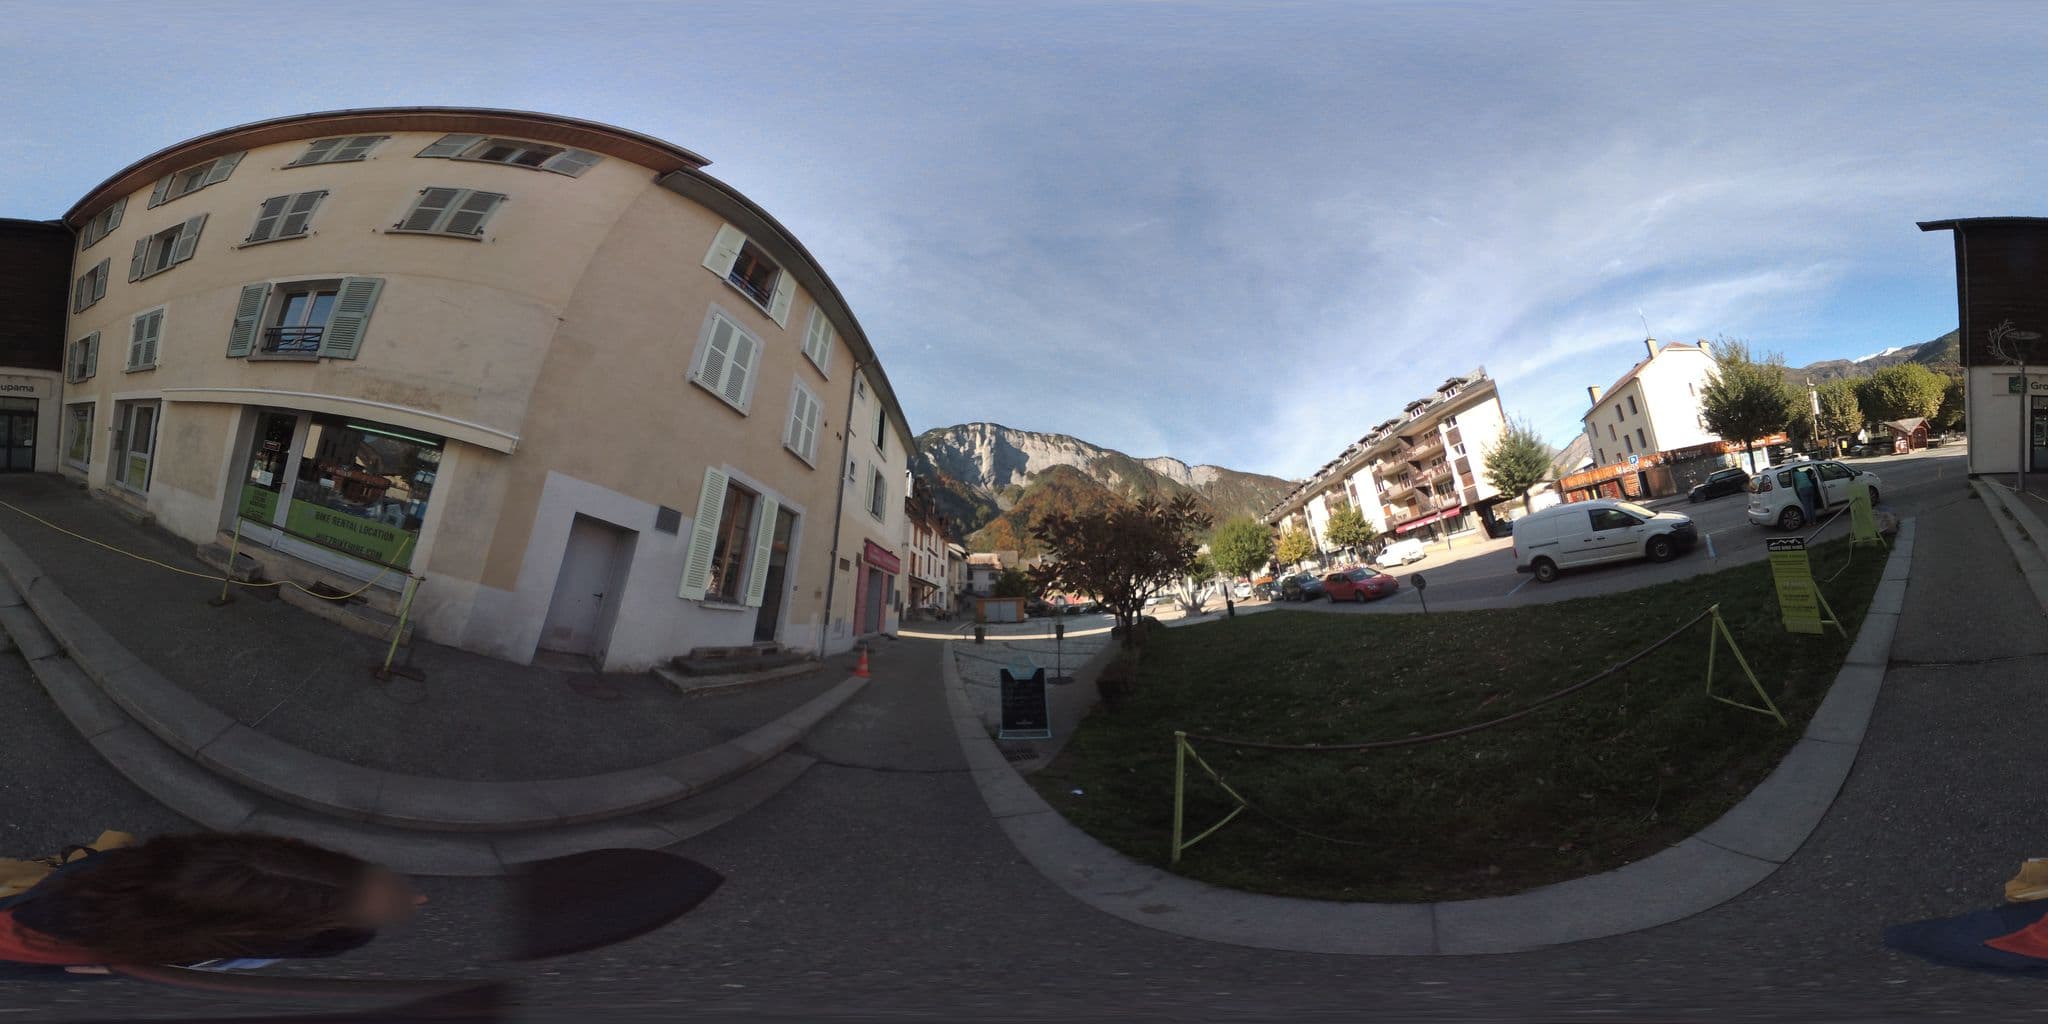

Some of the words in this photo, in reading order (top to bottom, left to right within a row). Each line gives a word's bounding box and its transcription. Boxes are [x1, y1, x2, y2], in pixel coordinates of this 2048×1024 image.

[0, 384, 34, 393] upama
[316, 511, 332, 524] BIKE
[333, 516, 357, 533] RENTAL
[359, 524, 394, 542] LOCATION
